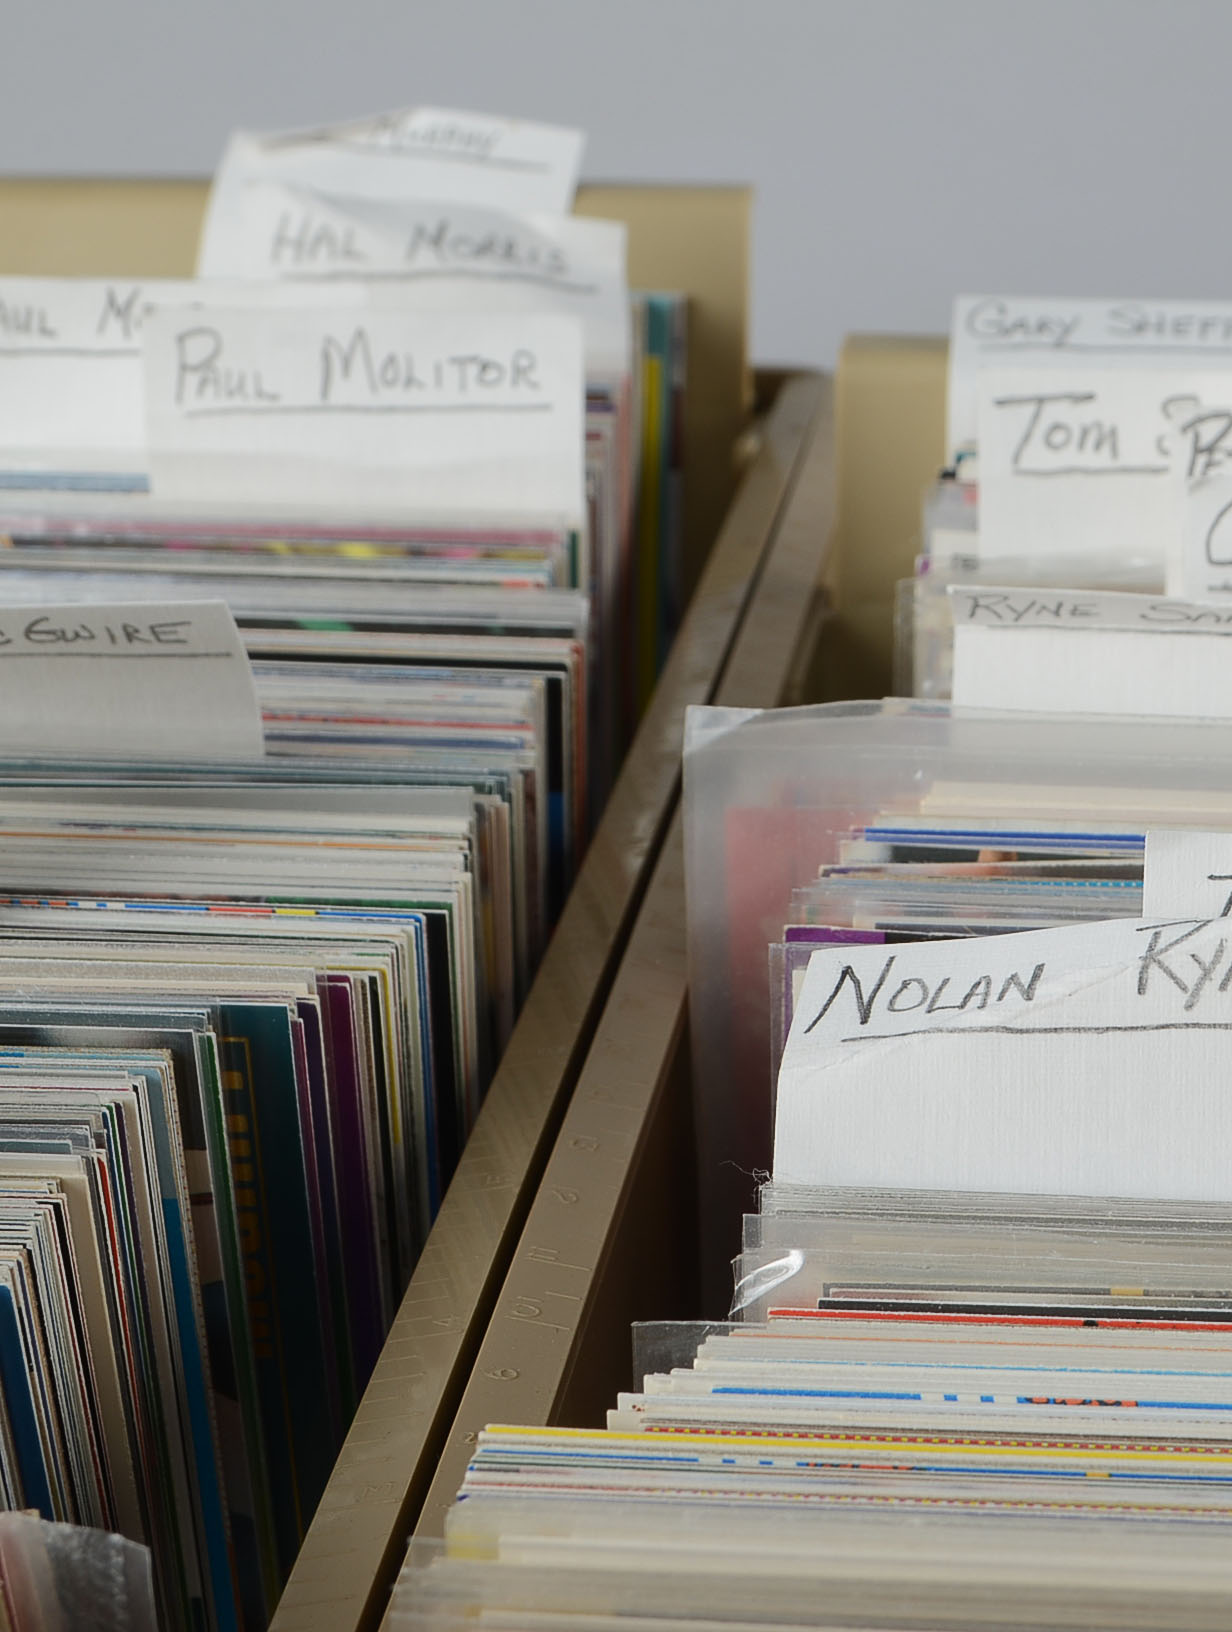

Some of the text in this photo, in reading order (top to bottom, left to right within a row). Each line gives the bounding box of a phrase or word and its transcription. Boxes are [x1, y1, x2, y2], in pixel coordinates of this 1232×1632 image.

[272, 212, 570, 276] HAL MORRIS
[966, 303, 1083, 348] GARY
[174, 325, 540, 407] PAUL MOLITOR
[992, 391, 1120, 466] TOM
[966, 593, 1100, 624] RYNE
[803, 955, 1047, 1036] NOLAN
